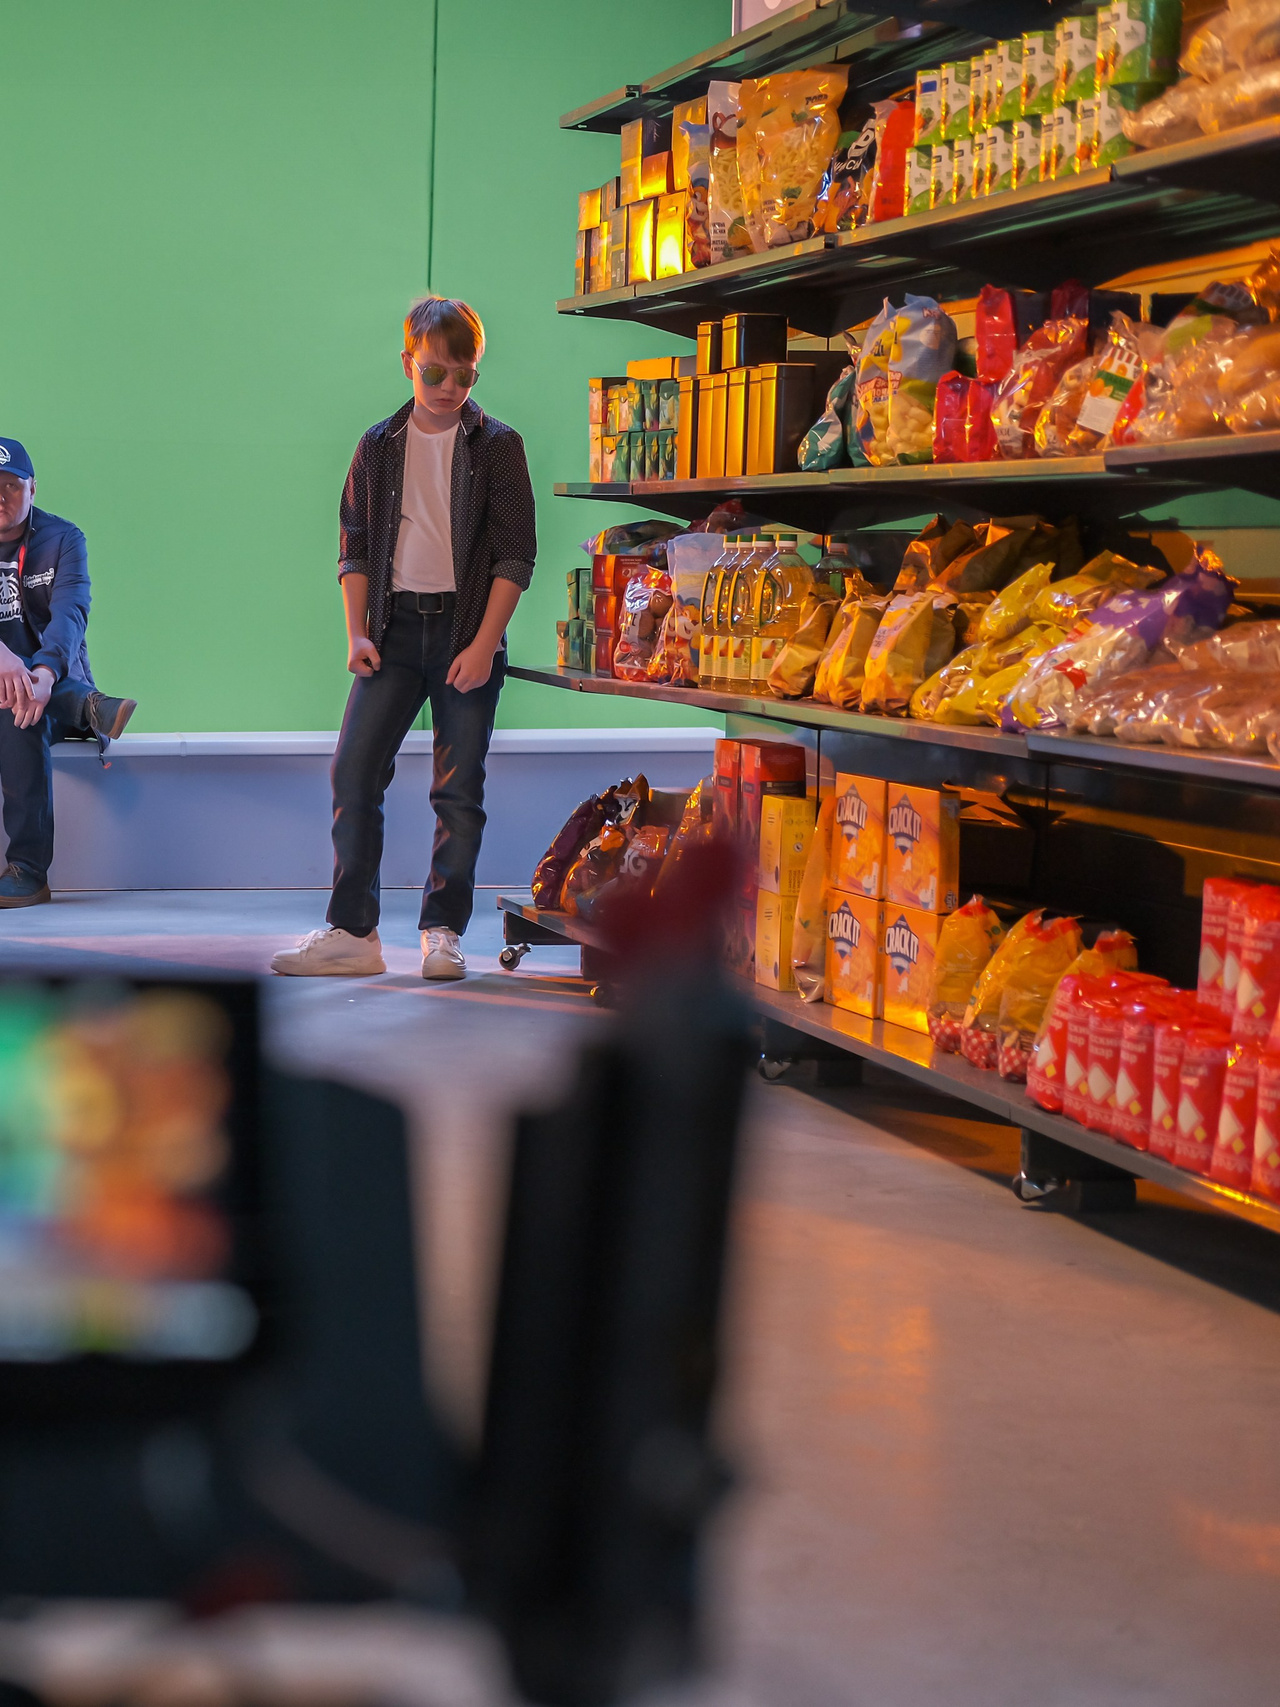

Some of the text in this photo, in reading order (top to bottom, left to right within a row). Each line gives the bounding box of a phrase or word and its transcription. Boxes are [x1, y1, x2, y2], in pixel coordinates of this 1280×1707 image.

[828, 912, 861, 949] CRACK IT
[885, 926, 919, 965] CRACK IT
